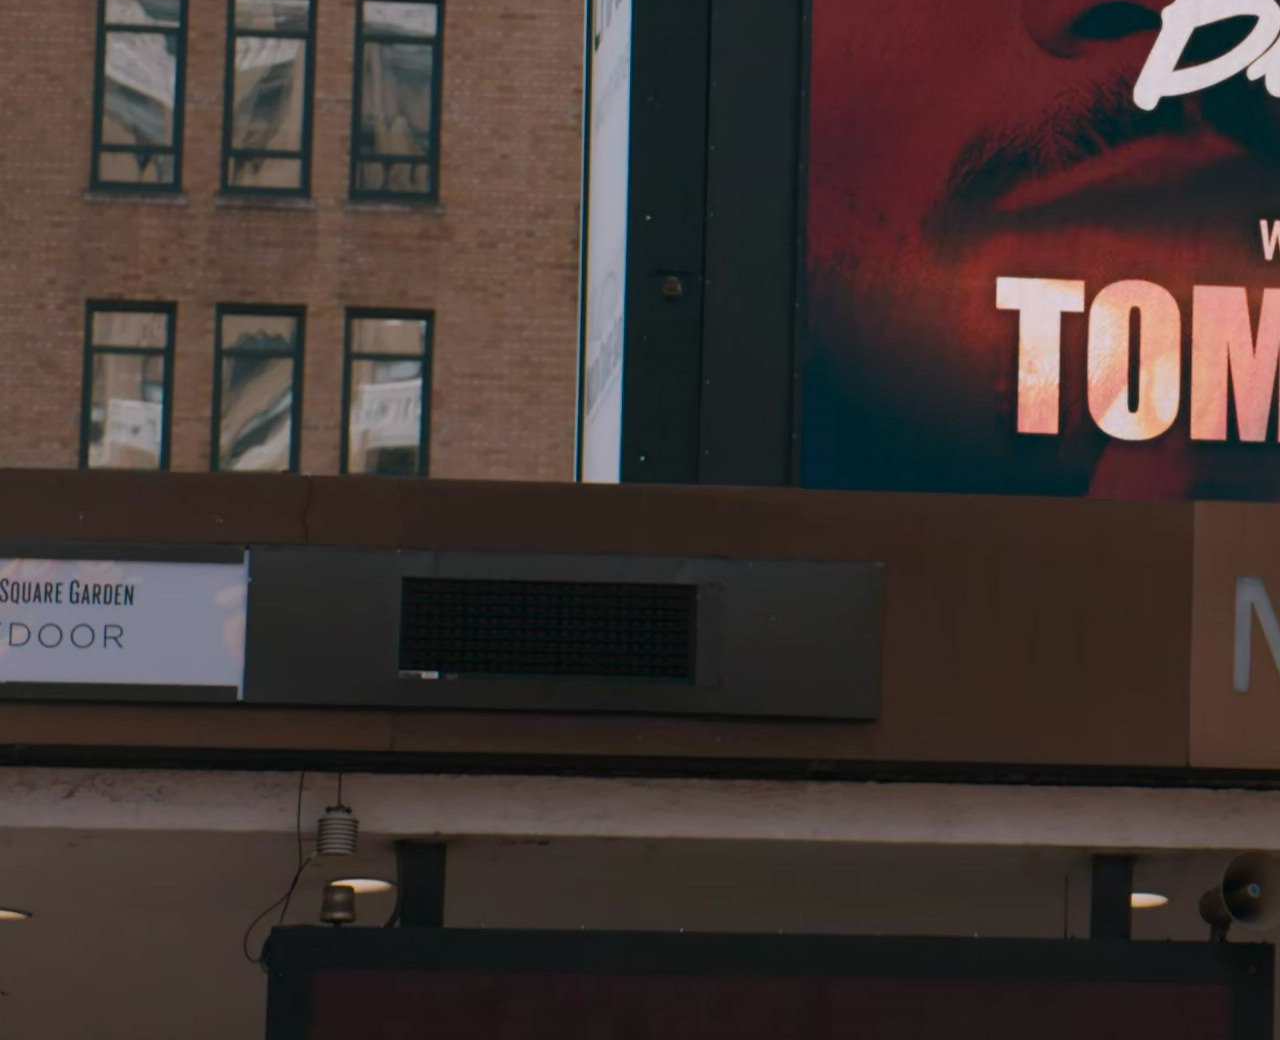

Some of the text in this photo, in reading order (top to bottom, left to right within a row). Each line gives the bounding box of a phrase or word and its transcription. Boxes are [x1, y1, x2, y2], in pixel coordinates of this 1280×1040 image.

[0, 578, 135, 606] SQUARE GARDEN
[0, 622, 124, 649] DOOR
